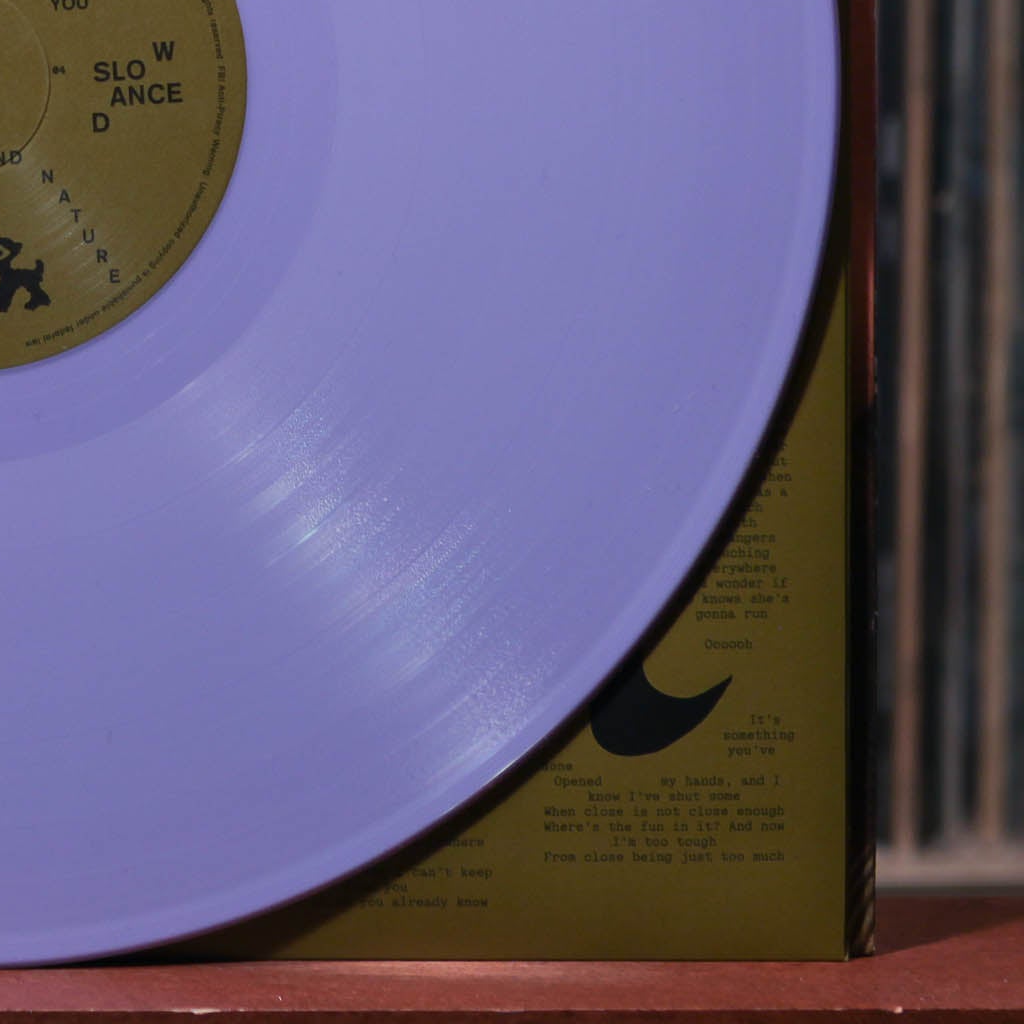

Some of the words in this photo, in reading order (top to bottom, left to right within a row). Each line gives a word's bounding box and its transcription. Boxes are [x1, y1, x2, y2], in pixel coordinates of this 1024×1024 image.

[723, 729, 795, 743] something
[727, 744, 776, 758] you've
[544, 806, 576, 817] When
[584, 806, 624, 817] close
[632, 806, 649, 817] is
[656, 806, 681, 817] not
[688, 806, 729, 817] close
[736, 805, 785, 819] enough
